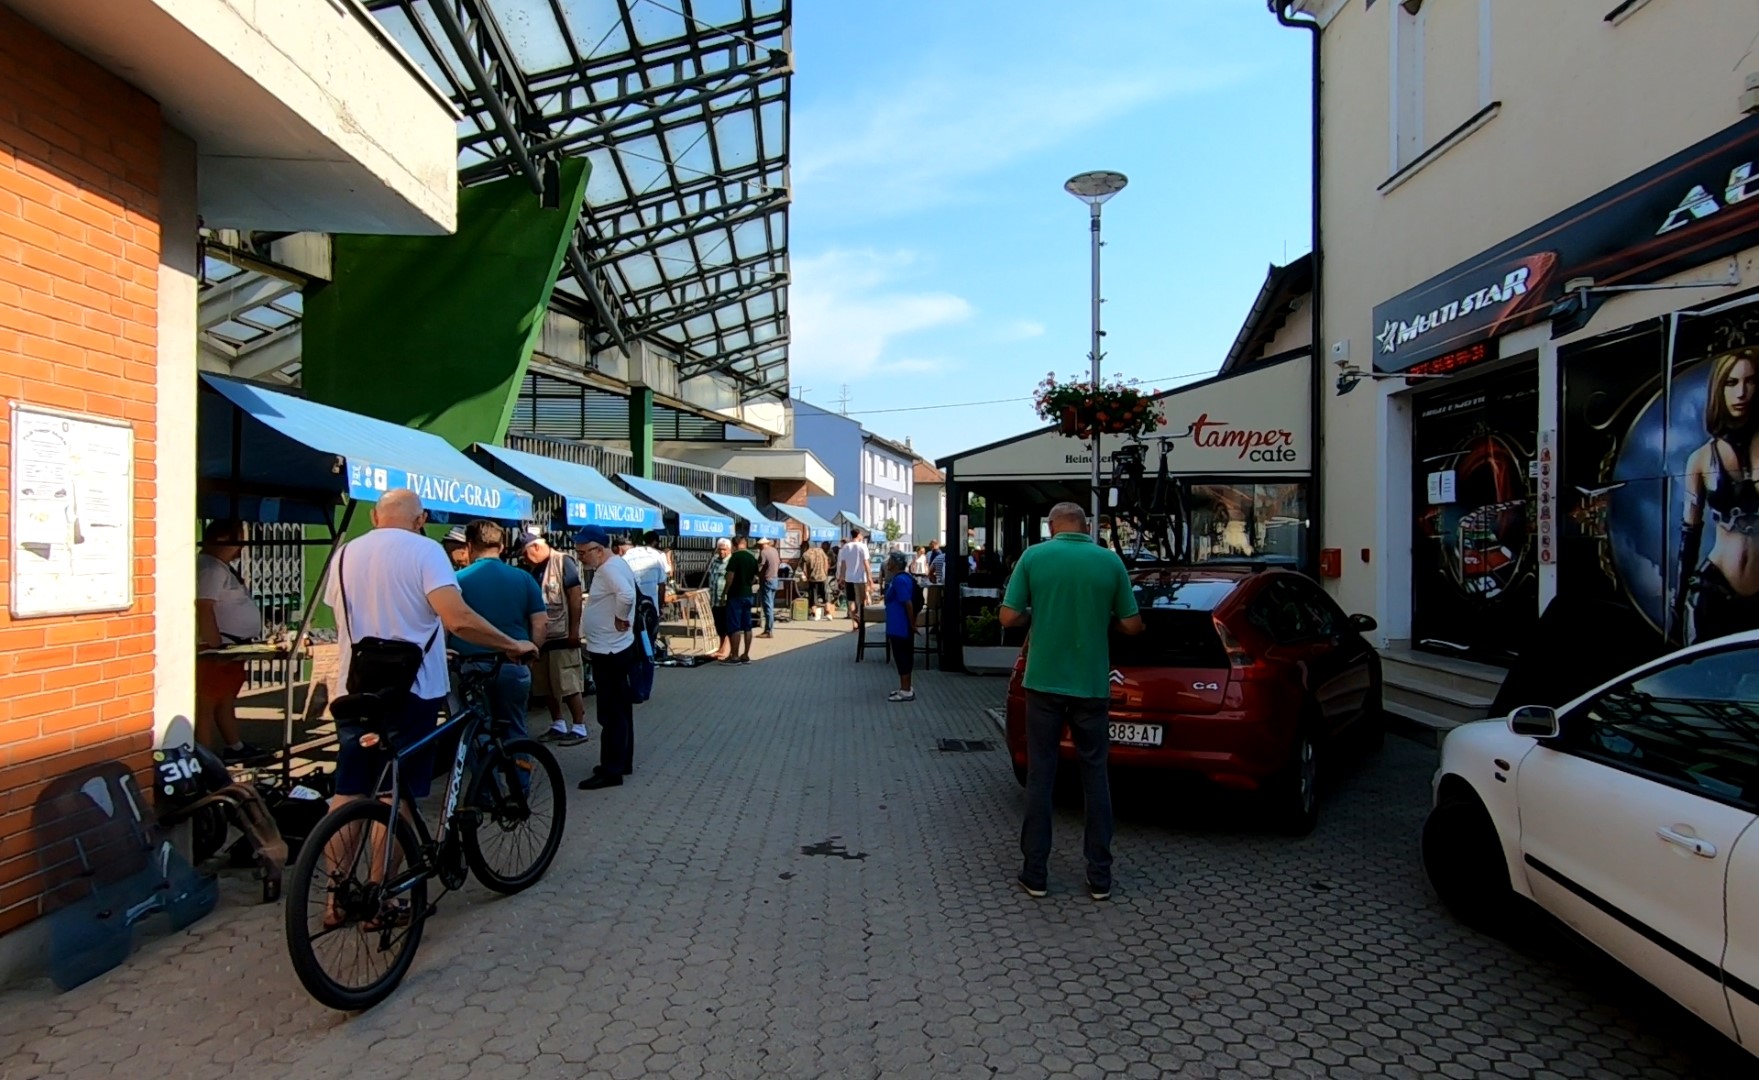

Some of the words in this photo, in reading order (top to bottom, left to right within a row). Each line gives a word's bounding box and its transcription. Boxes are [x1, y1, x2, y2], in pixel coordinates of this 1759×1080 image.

[1192, 413, 1293, 459] tamper
[1249, 444, 1296, 462] cafe
[1193, 681, 1218, 690] C4
[160, 757, 202, 782] 314
